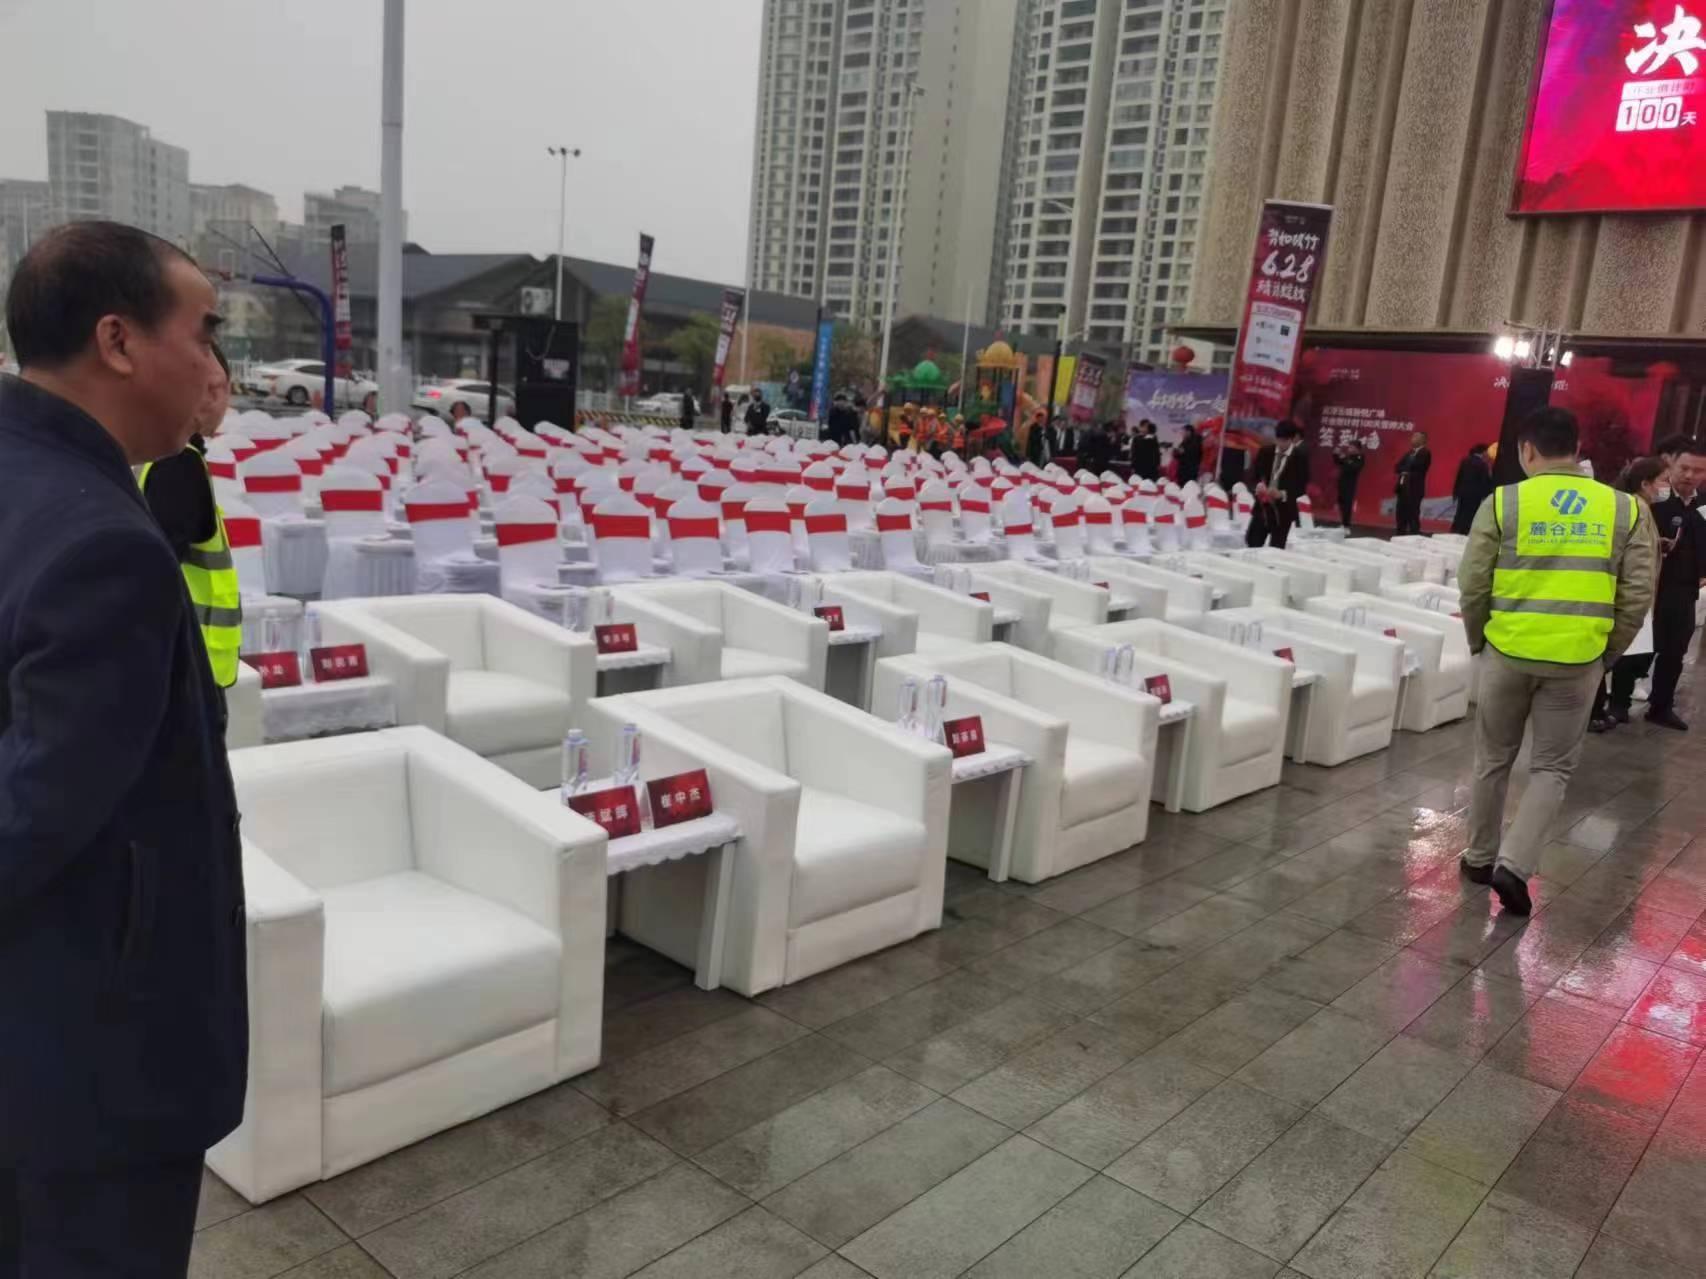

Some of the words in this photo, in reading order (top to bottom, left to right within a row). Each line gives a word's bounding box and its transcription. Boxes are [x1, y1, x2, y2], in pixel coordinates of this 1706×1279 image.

[1625, 3, 1706, 77] 决
[1625, 102, 1678, 125] 100
[1261, 249, 1314, 283] 6.28
